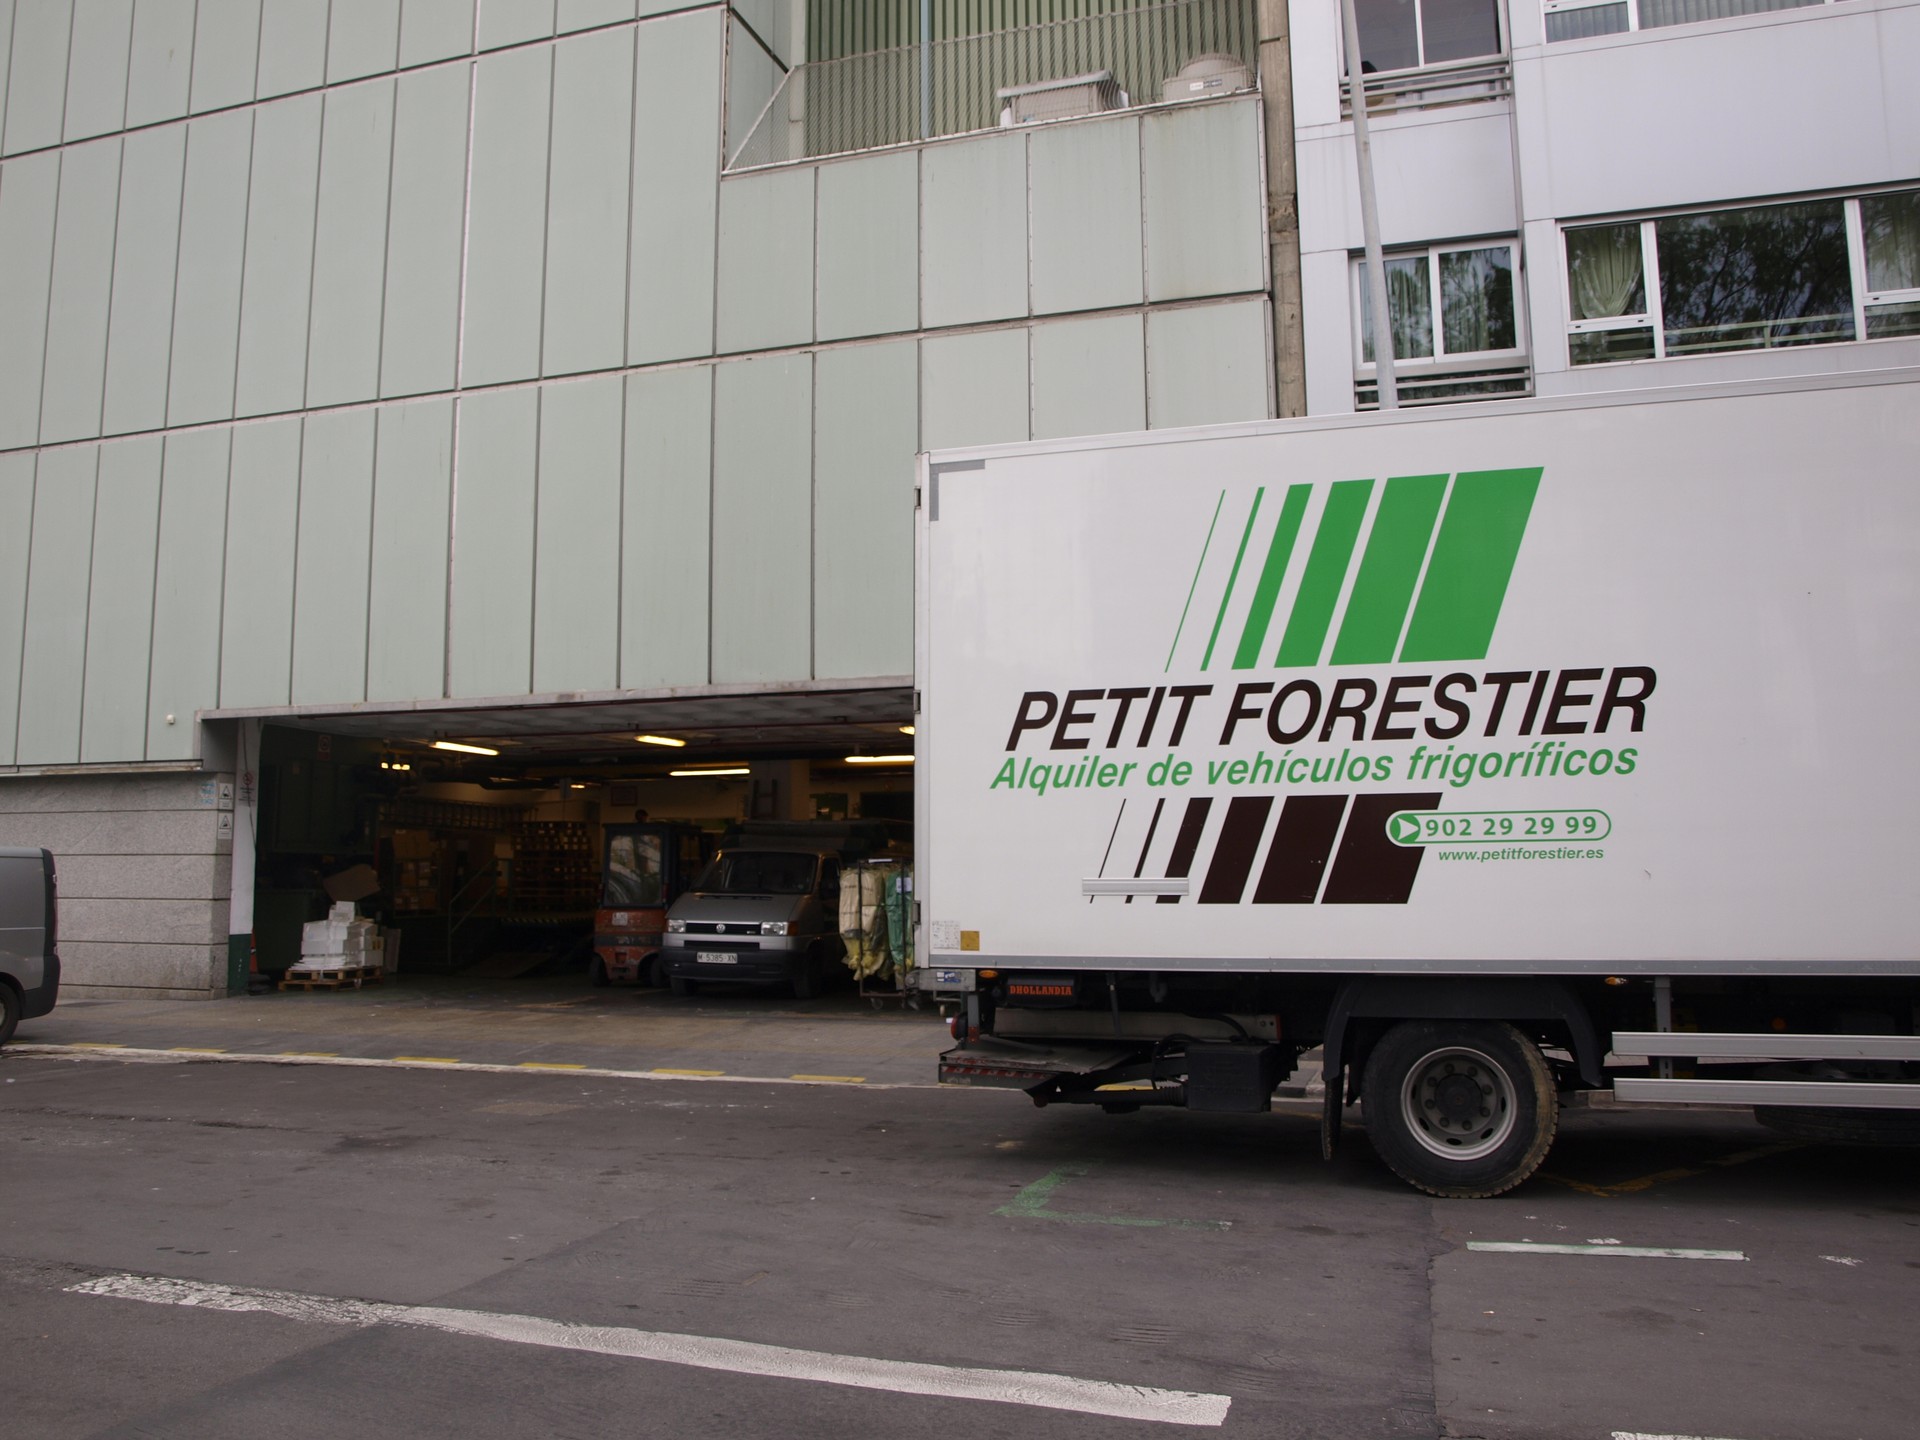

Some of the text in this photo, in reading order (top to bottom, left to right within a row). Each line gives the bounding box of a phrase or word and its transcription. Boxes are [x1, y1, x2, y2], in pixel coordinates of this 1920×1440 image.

[1005, 665, 1657, 752] PETIT FORESTIER
[990, 741, 1639, 796] Alquiler de vehículos frigoríficos
[1425, 815, 1598, 837] 902 29 29 99
[1438, 847, 1604, 862] www.petitforestier.es
[1010, 985, 1072, 996] DHOLLANDIA
